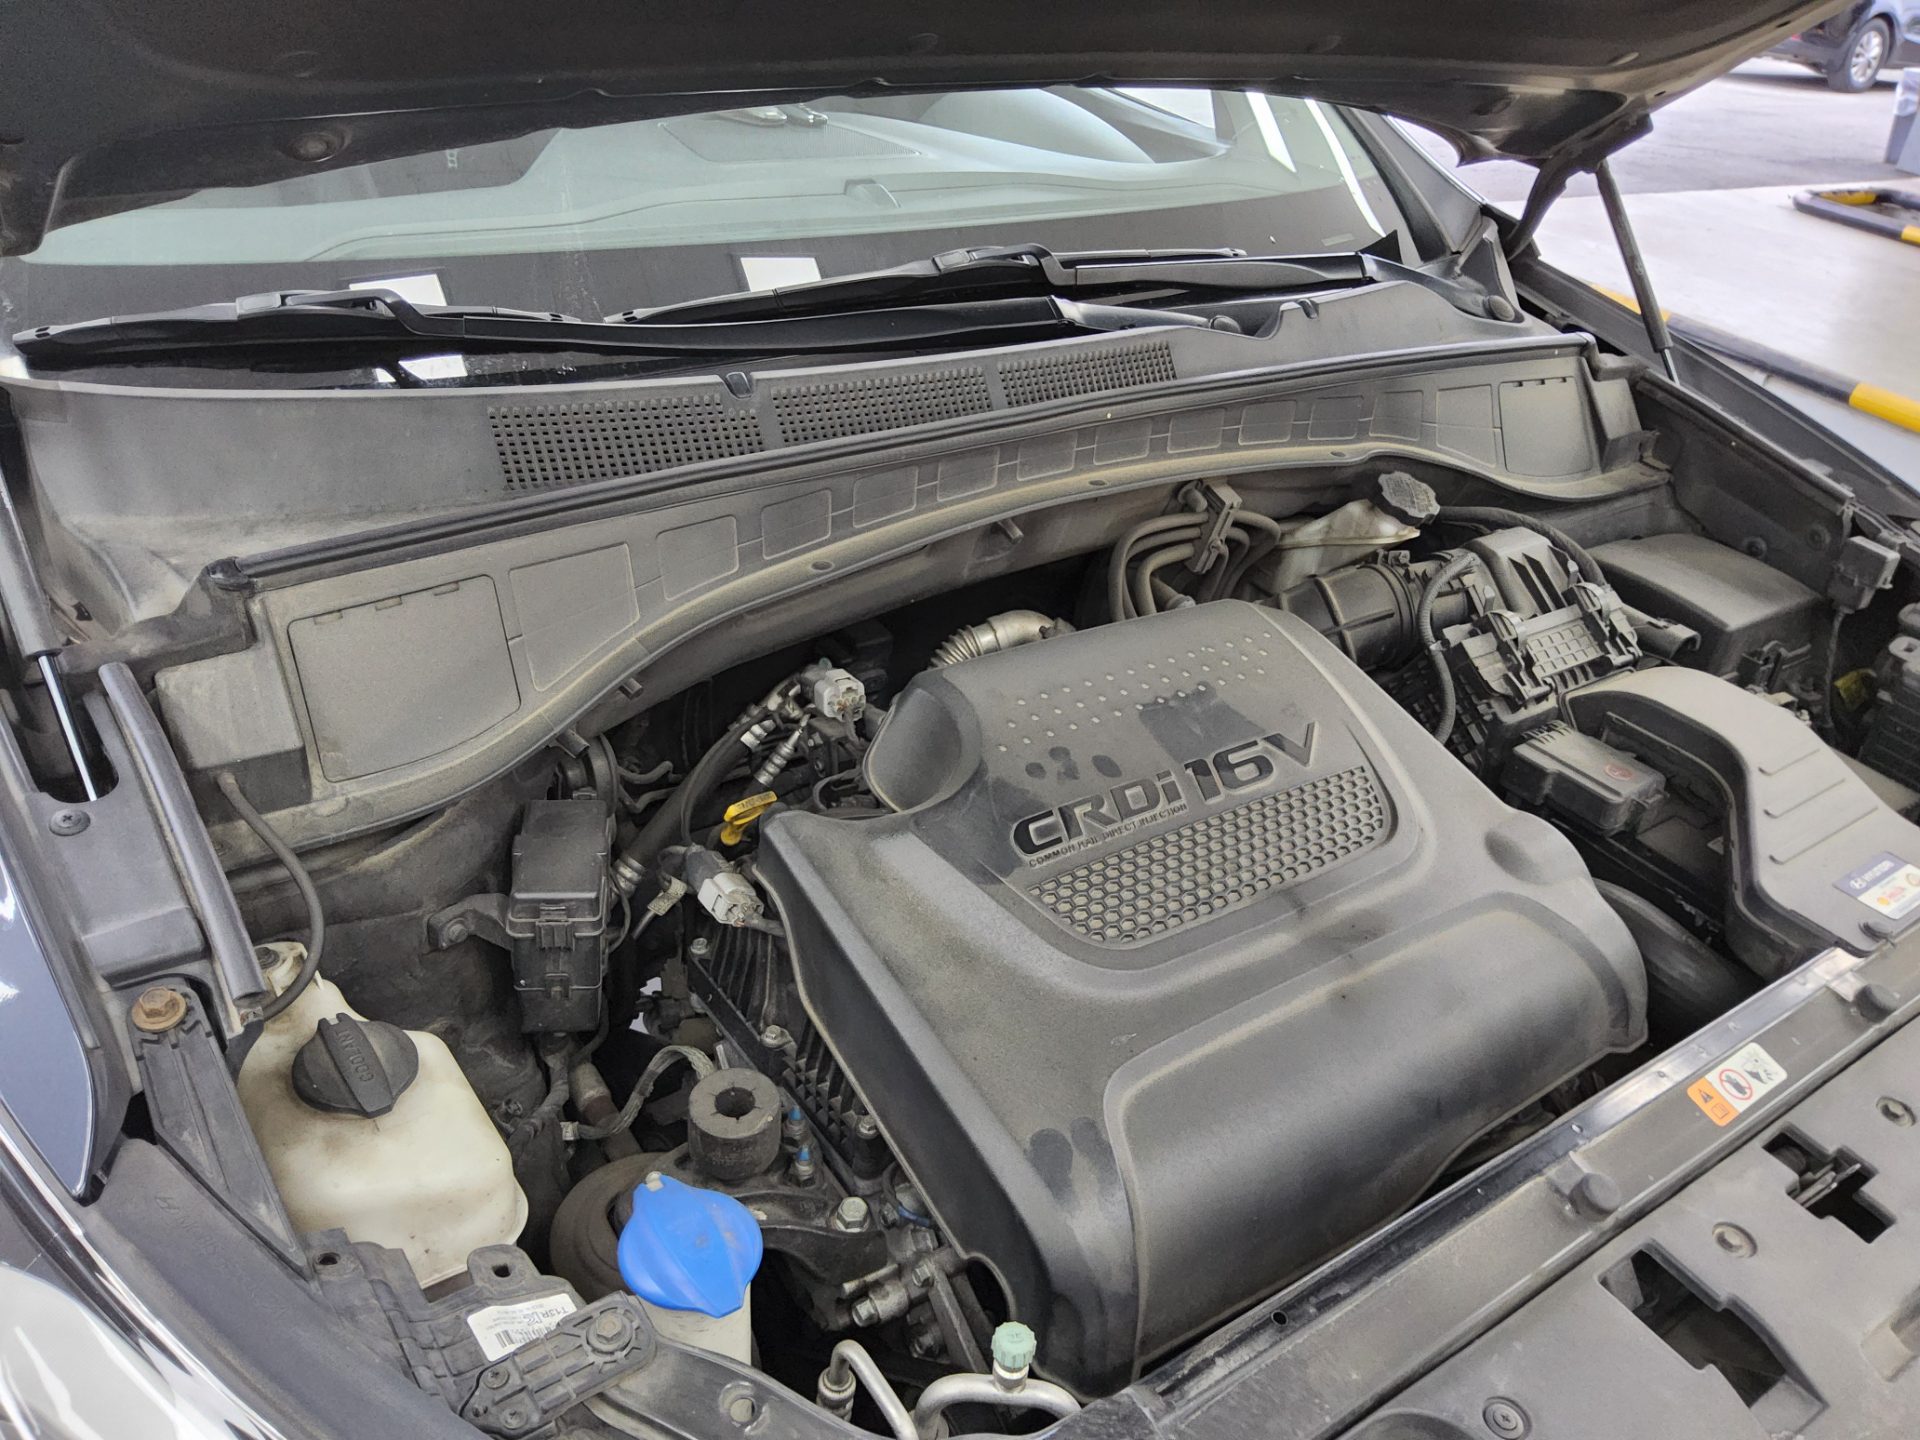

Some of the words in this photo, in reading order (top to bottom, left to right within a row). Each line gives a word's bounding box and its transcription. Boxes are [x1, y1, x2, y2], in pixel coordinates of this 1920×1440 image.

[1013, 769, 1182, 855] CRDi
[1184, 721, 1317, 802] 16V
[1028, 844, 1076, 867] COMMON
[1102, 822, 1138, 840] DIRECT
[335, 1029, 375, 1083] COOLANT
